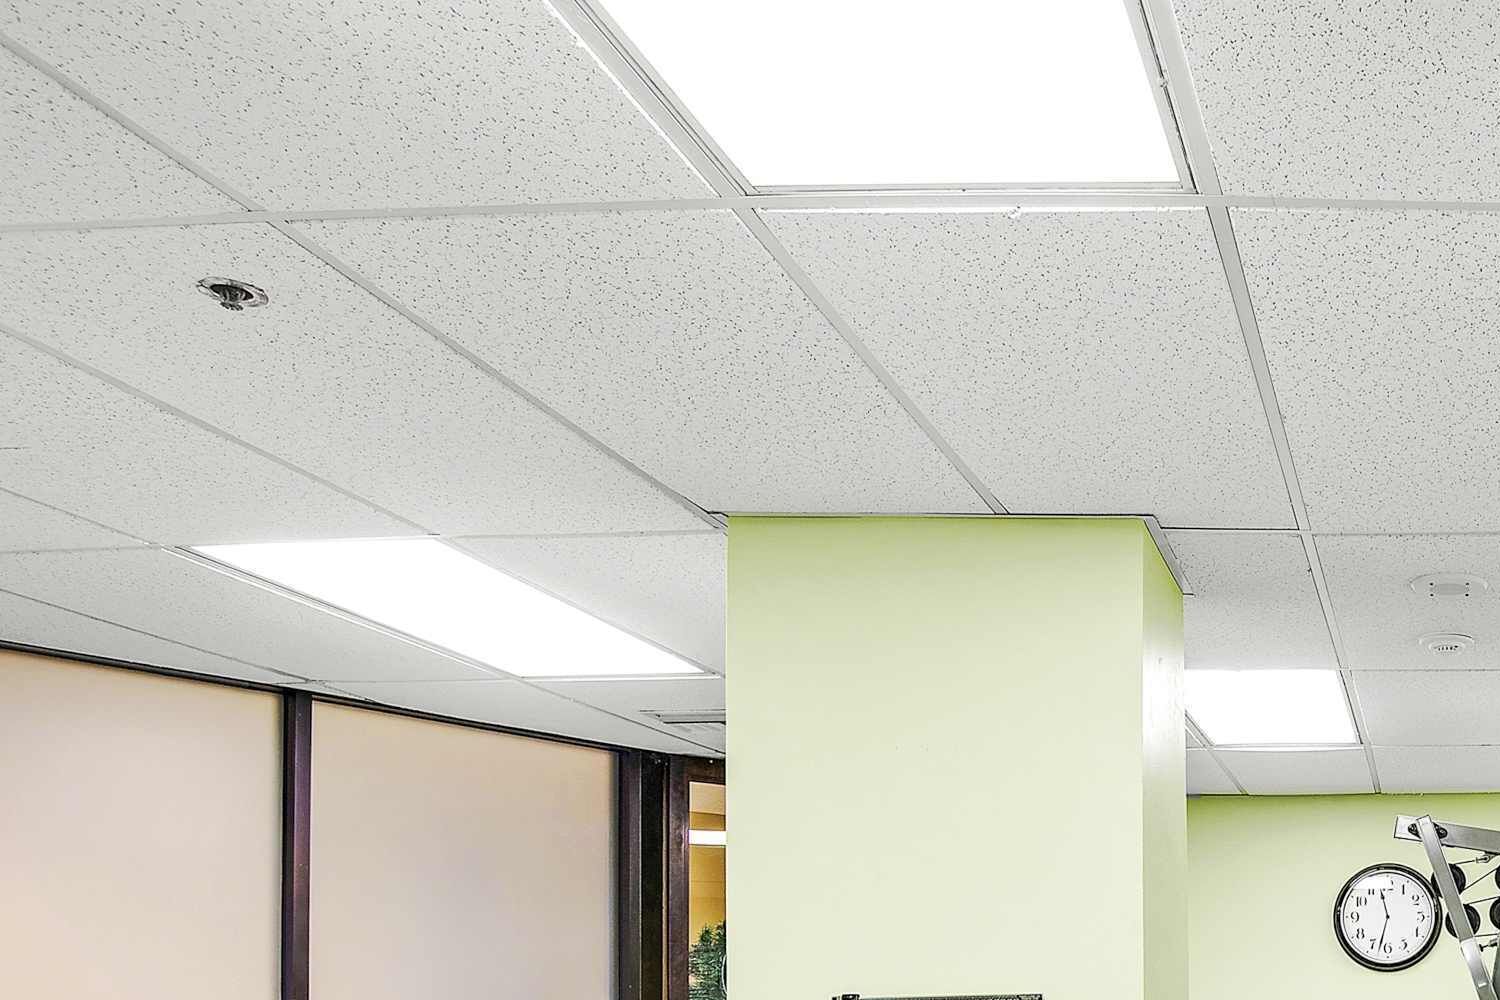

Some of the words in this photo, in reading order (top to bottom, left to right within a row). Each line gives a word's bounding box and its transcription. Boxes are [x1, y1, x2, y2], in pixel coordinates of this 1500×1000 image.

[1356, 896, 1367, 907] 10
[1411, 894, 1420, 906] 2
[1350, 911, 1360, 923] 9
[1356, 928, 1365, 939] 8
[1383, 942, 1393, 954] 6
